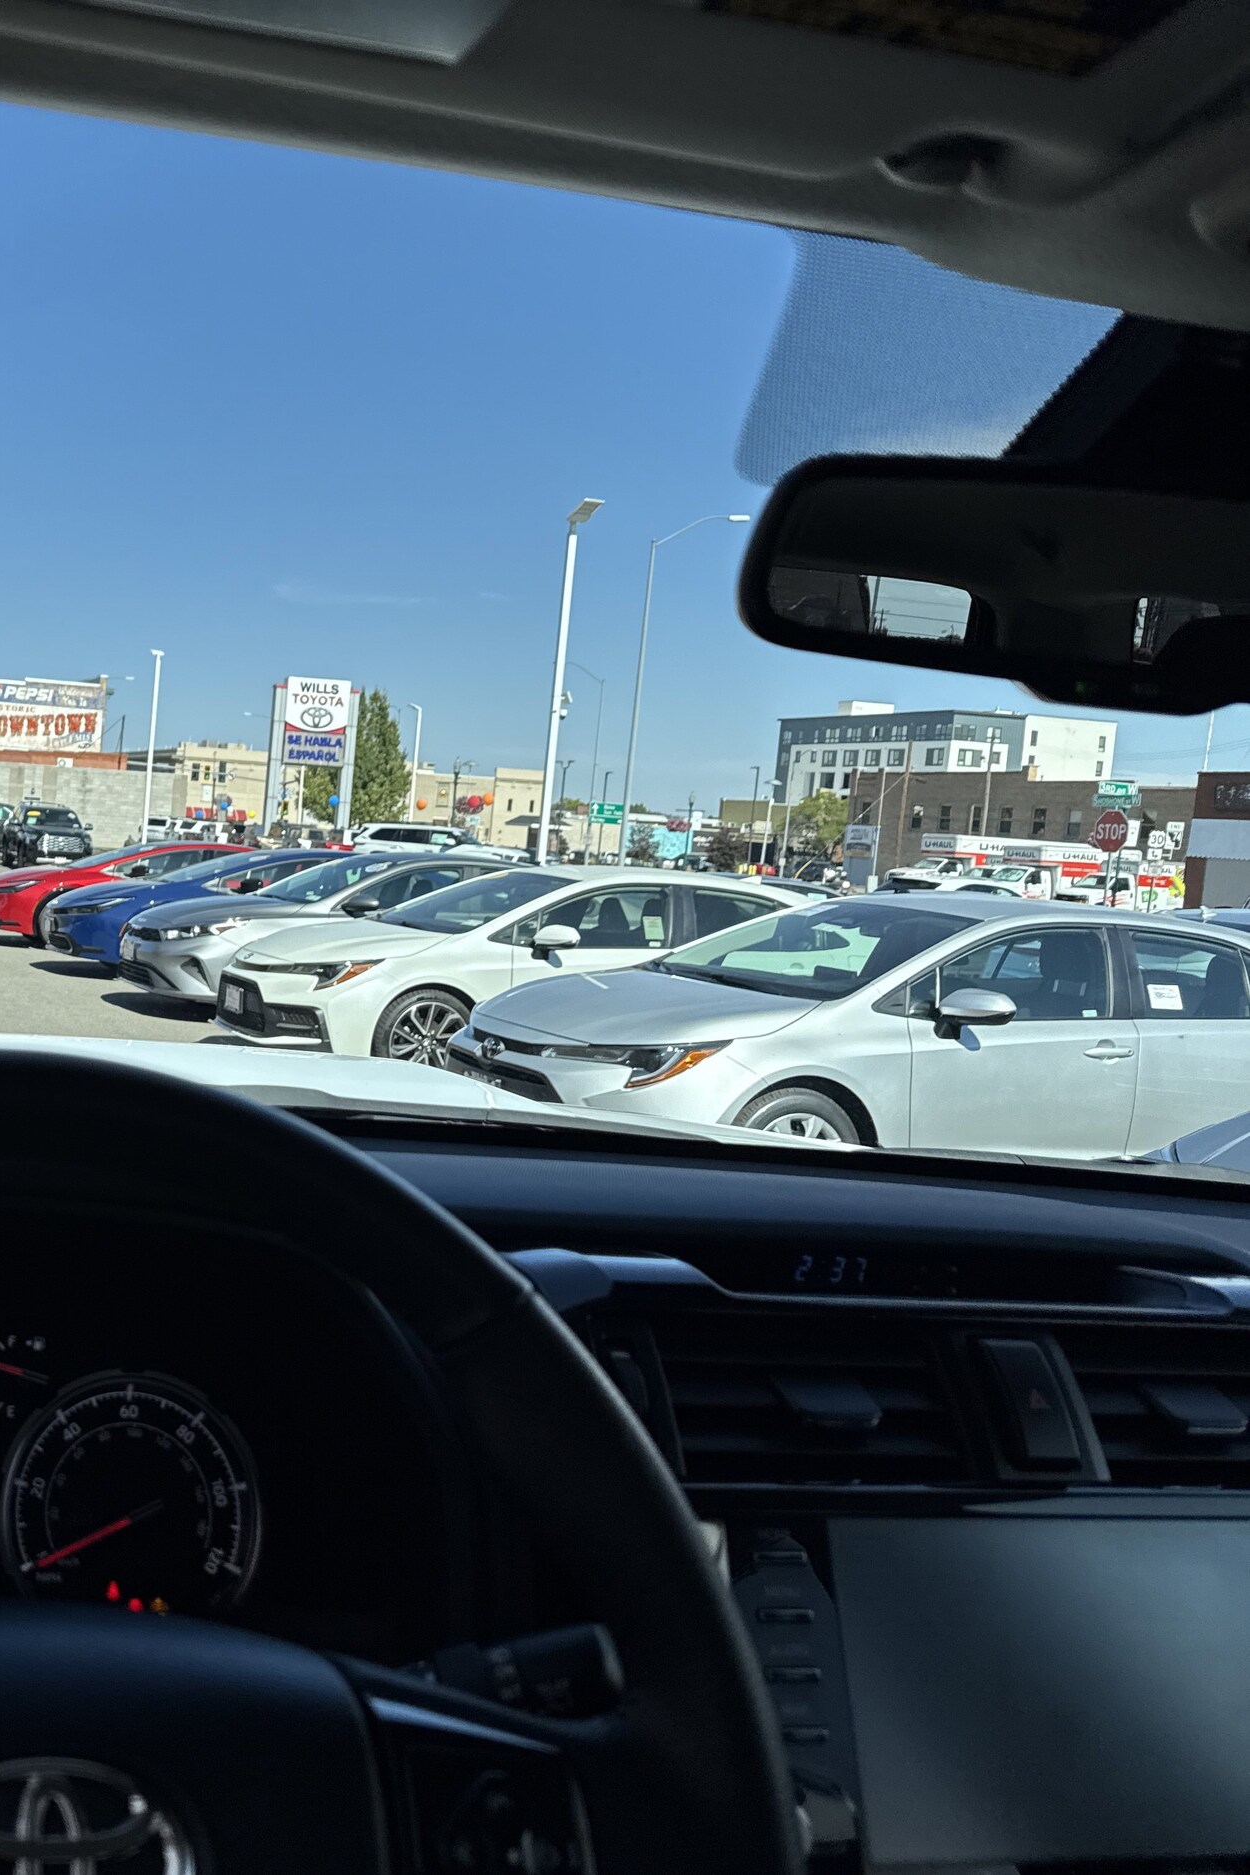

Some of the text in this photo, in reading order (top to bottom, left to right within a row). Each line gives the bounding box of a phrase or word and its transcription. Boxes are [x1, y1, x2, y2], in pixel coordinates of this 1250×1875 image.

[3, 685, 55, 702] PEPSI
[301, 682, 339, 695] WILLS
[292, 693, 344, 707] TOYOTA
[287, 735, 343, 748] SE HABLA
[1100, 782, 1116, 794] 3RD
[1128, 784, 1138, 795] W
[1096, 823, 1127, 840] STOP
[1152, 834, 1164, 844] 30
[7, 1335, 17, 1347] F
[6, 1405, 16, 1418] E
[119, 1404, 139, 1419] 60
[63, 1422, 82, 1440] 40
[176, 1424, 195, 1444] 80
[30, 1477, 46, 1499] 20
[211, 1478, 228, 1507] 100
[203, 1546, 225, 1575] 120
